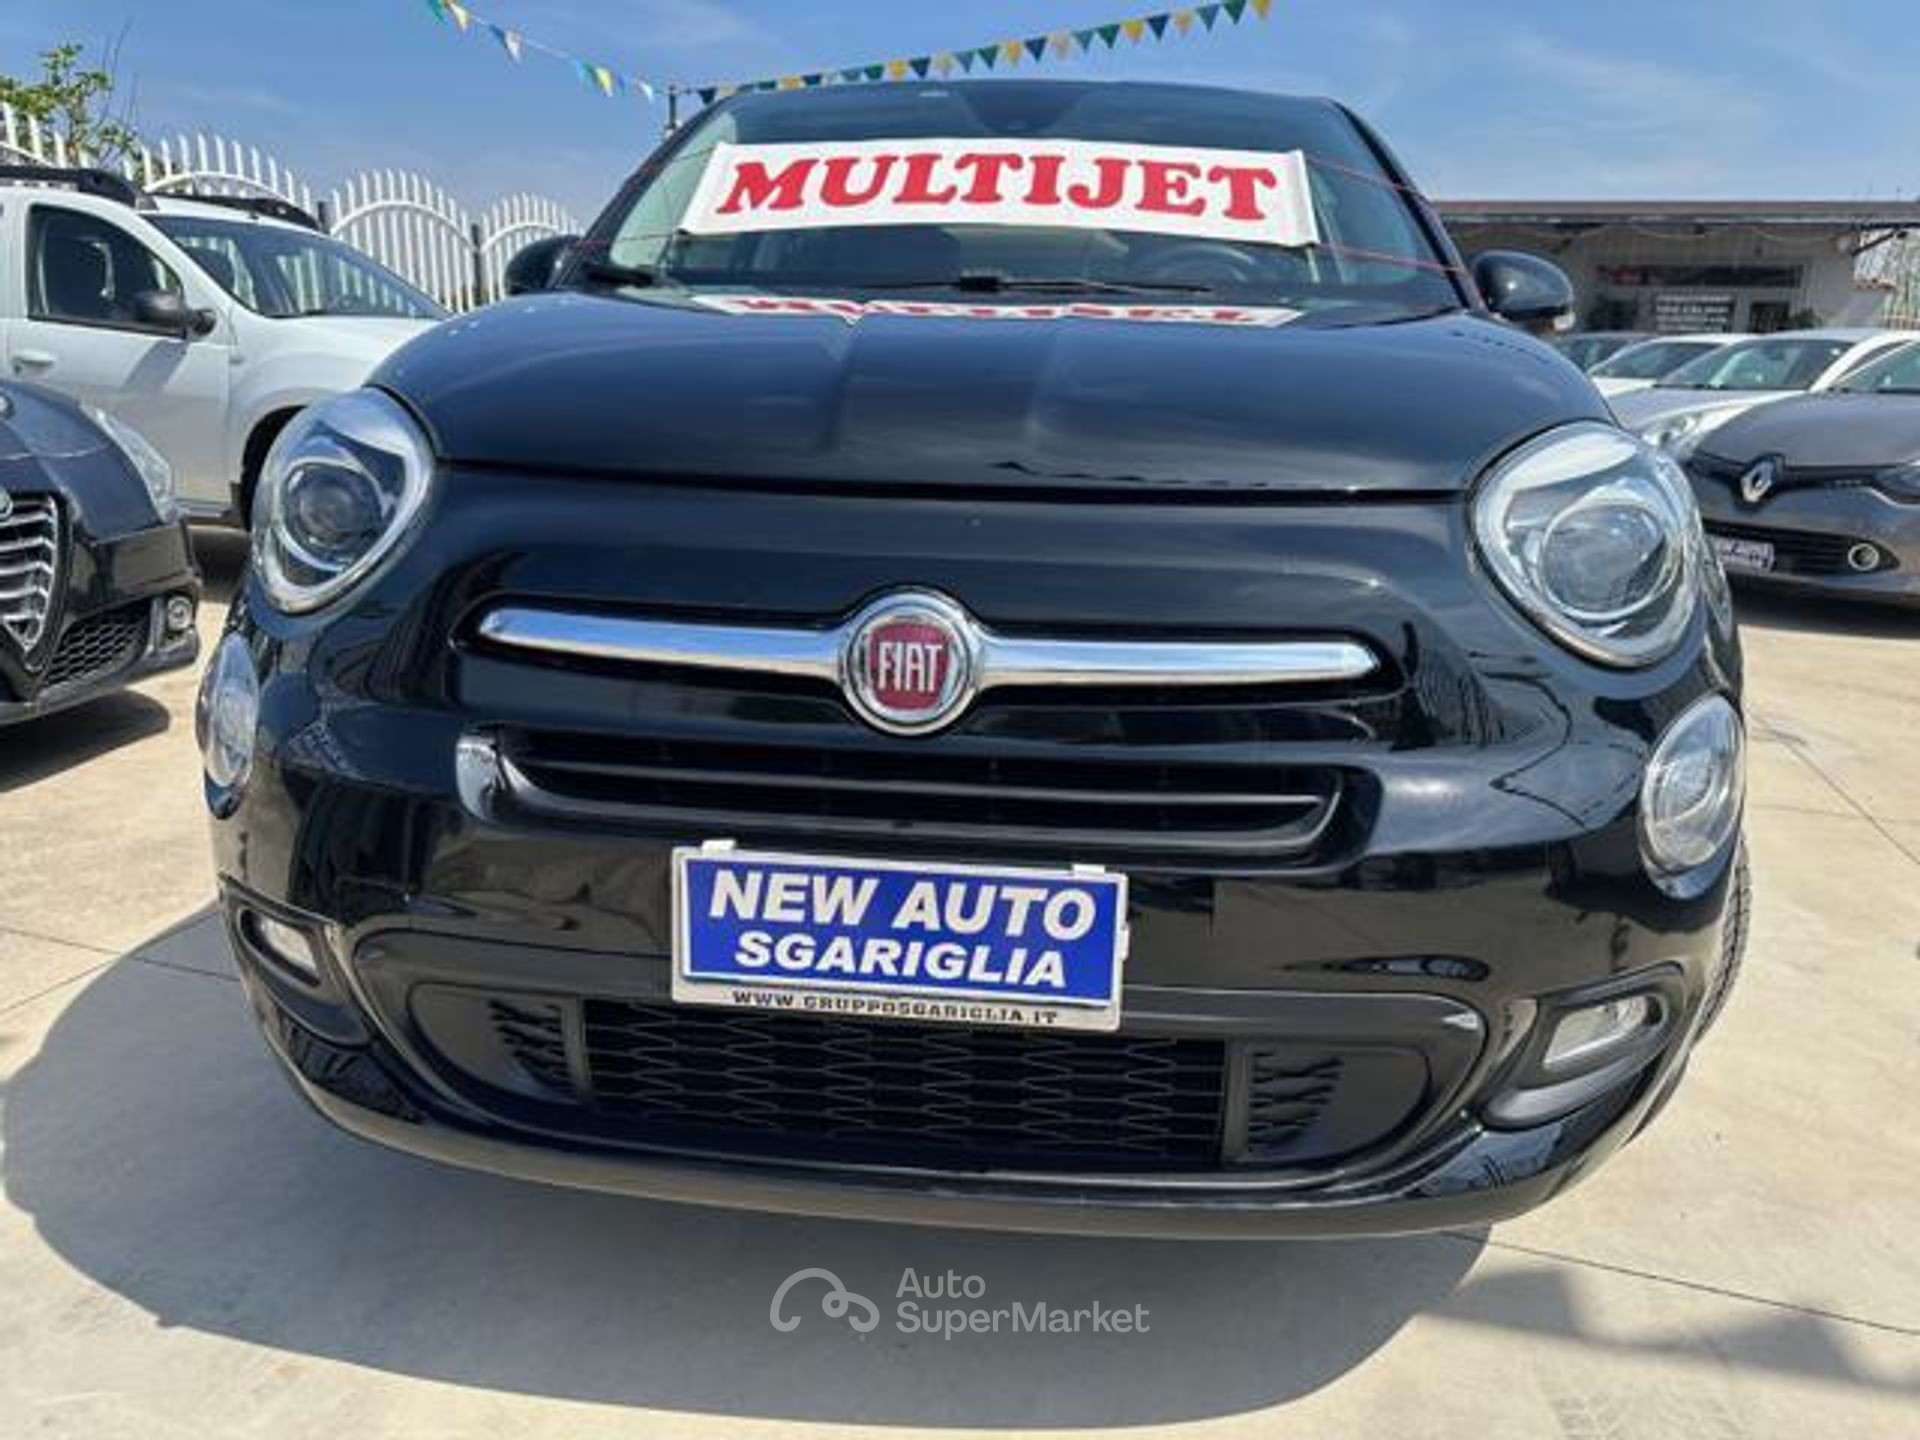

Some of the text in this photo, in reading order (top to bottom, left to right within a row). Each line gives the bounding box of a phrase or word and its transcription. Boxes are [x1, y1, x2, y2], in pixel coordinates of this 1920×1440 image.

[716, 153, 1277, 220] MULTIJET
[878, 641, 943, 693] FIAT
[708, 869, 1097, 941] NEW AUTO
[734, 930, 1067, 988] SGARIGLIA
[732, 990, 1058, 1024] WWW.GRUPPOSGARIGLIA.IT
